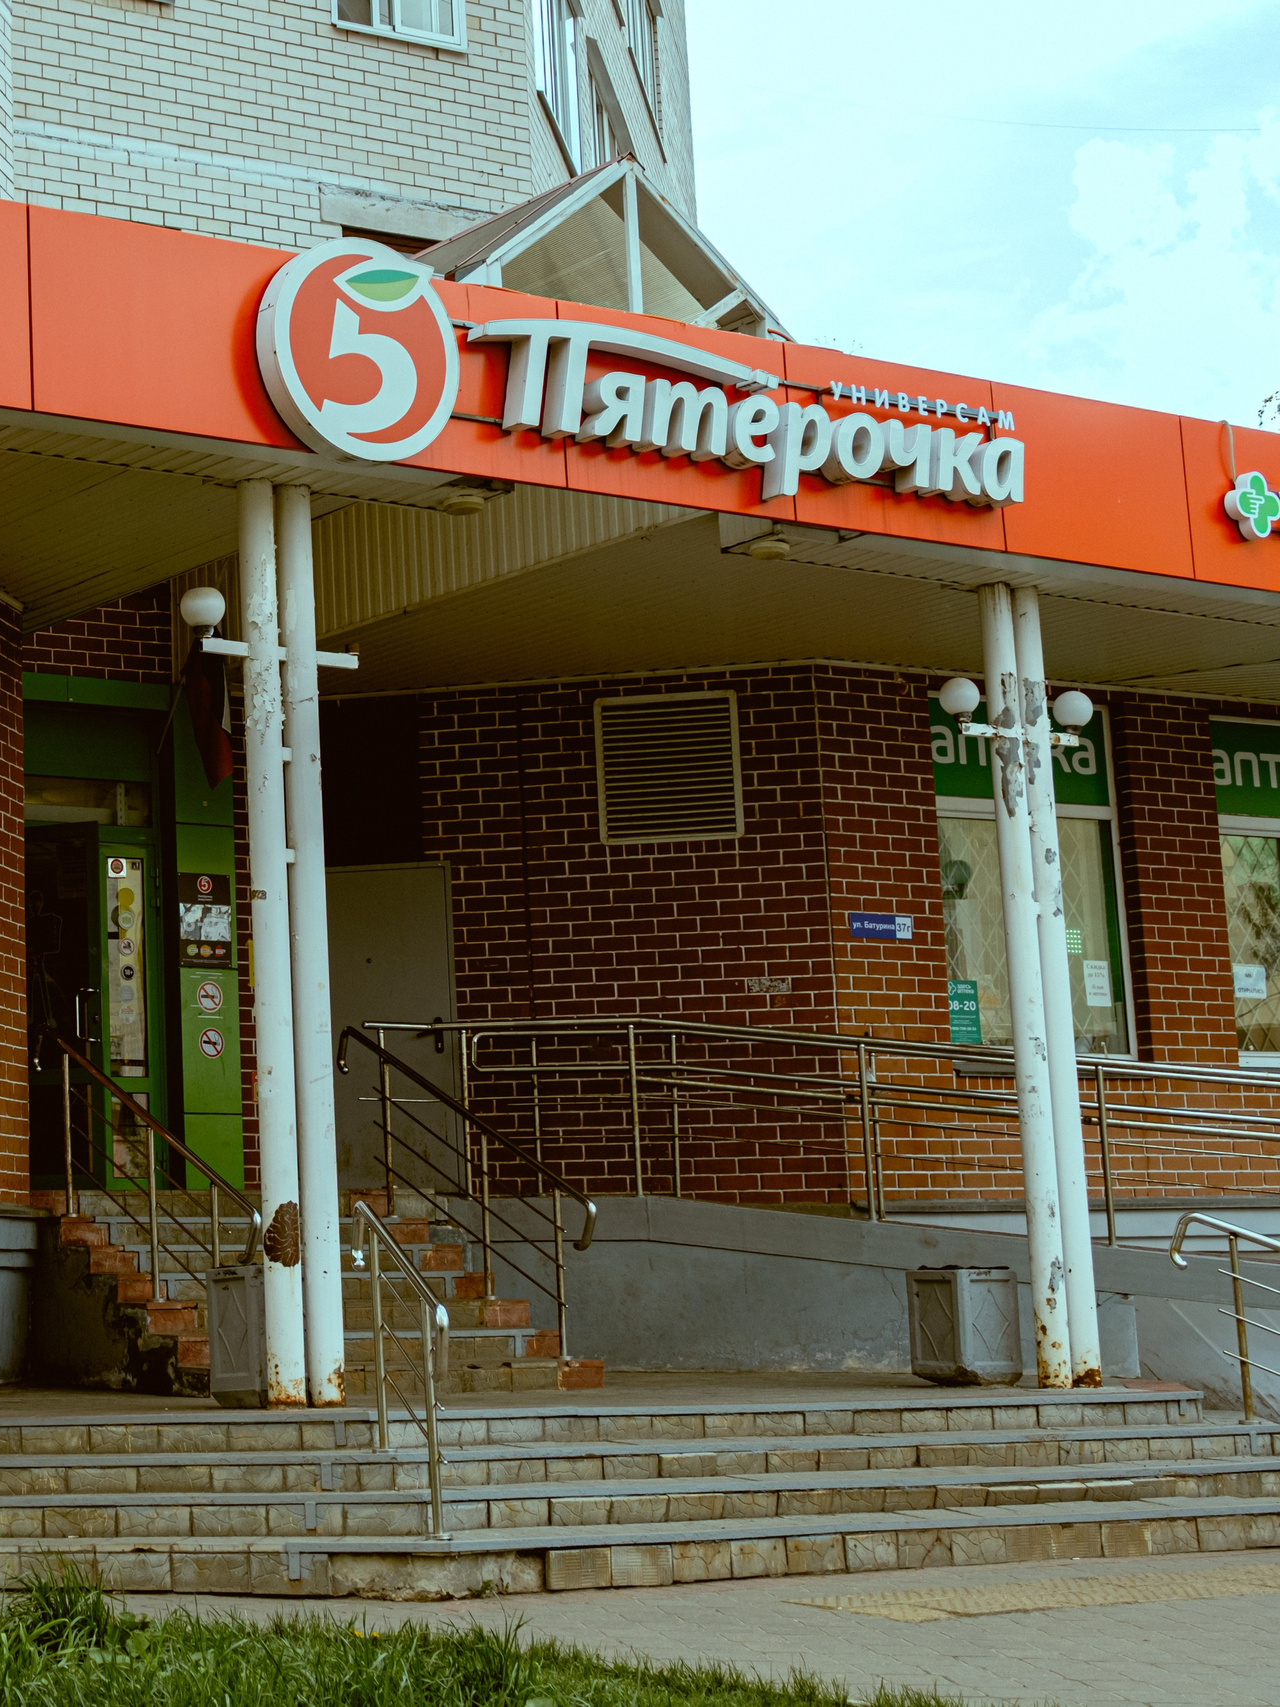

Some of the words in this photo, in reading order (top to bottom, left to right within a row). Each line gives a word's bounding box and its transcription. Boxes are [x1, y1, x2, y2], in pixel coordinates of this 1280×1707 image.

[317, 293, 420, 434] 5
[829, 380, 1016, 432] УНИВЕРСАМ
[852, 922, 862, 930] ул.
[864, 921, 896, 930] Батурина
[896, 922, 911, 932] 37г
